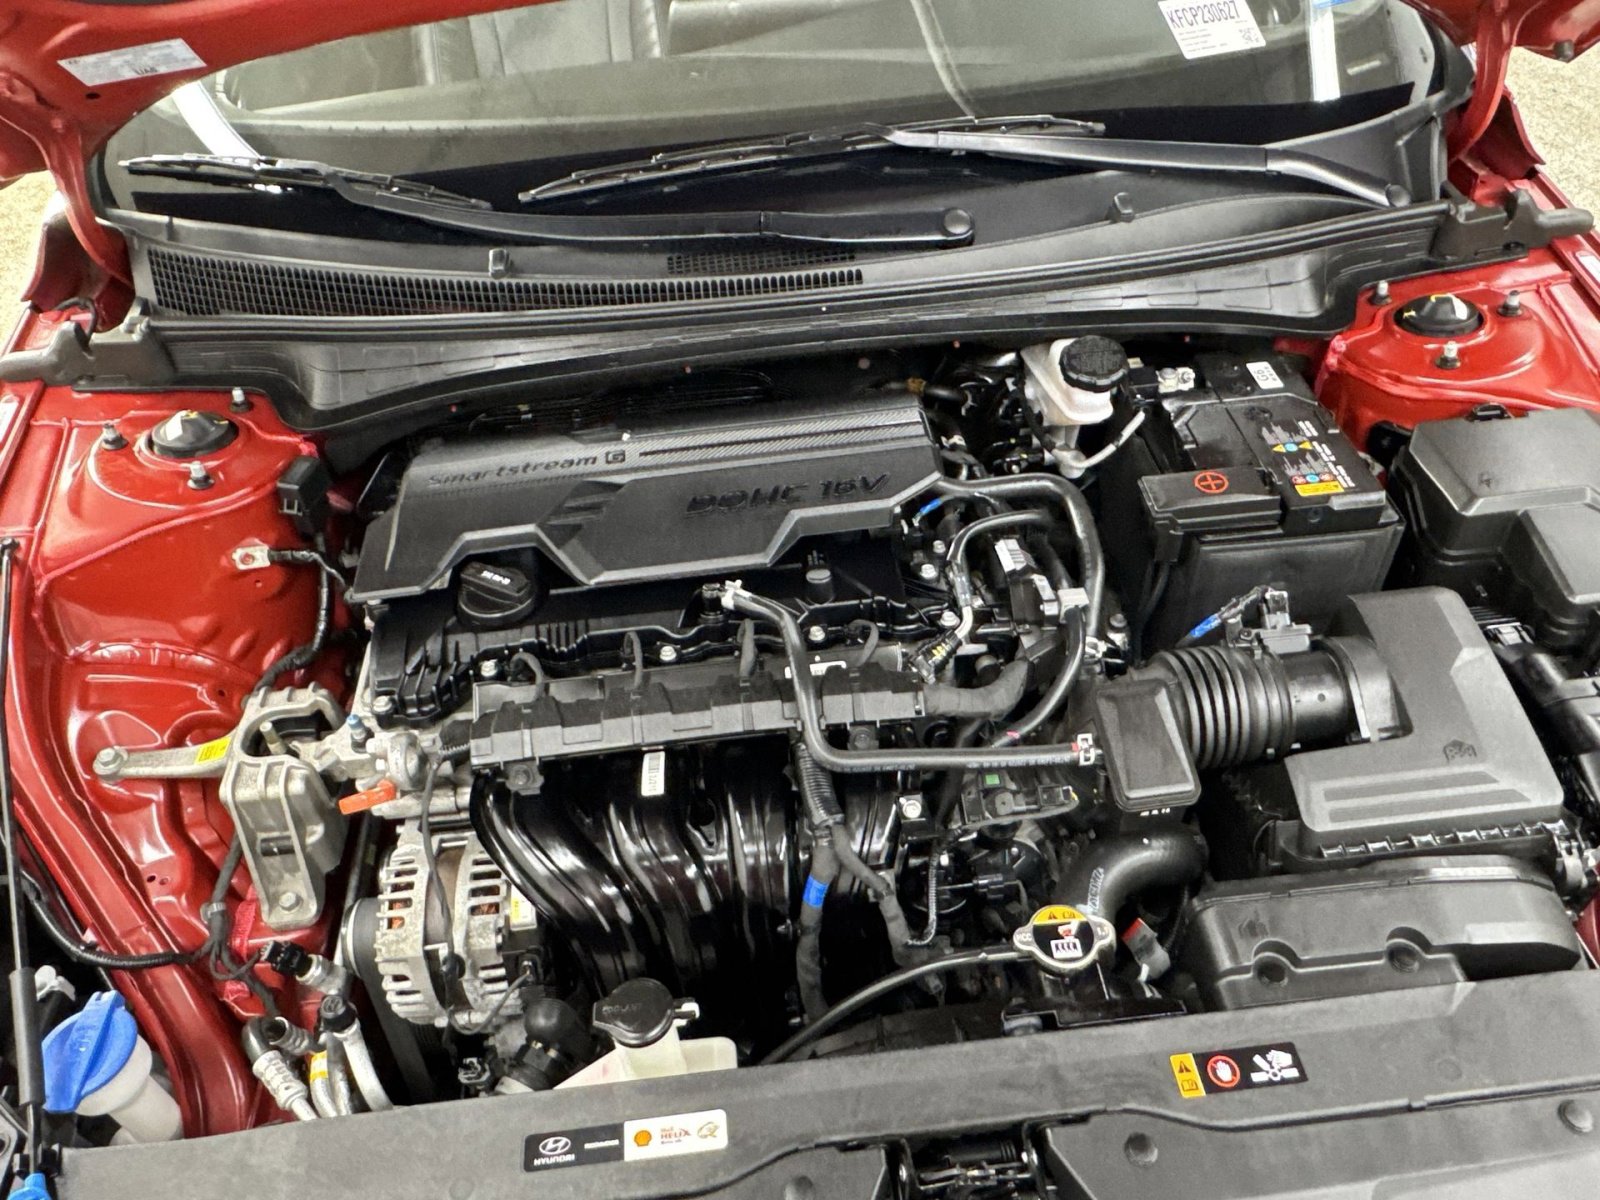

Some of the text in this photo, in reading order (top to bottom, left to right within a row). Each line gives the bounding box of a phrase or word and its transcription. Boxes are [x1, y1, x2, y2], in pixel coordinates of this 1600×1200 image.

[1166, 0, 1240, 29] KFCP230627
[427, 451, 625, 488] Smartstream G
[686, 472, 890, 514] DOHC 16V
[661, 1128, 692, 1140] HELIX
[533, 1153, 576, 1167] HYUNDAI
